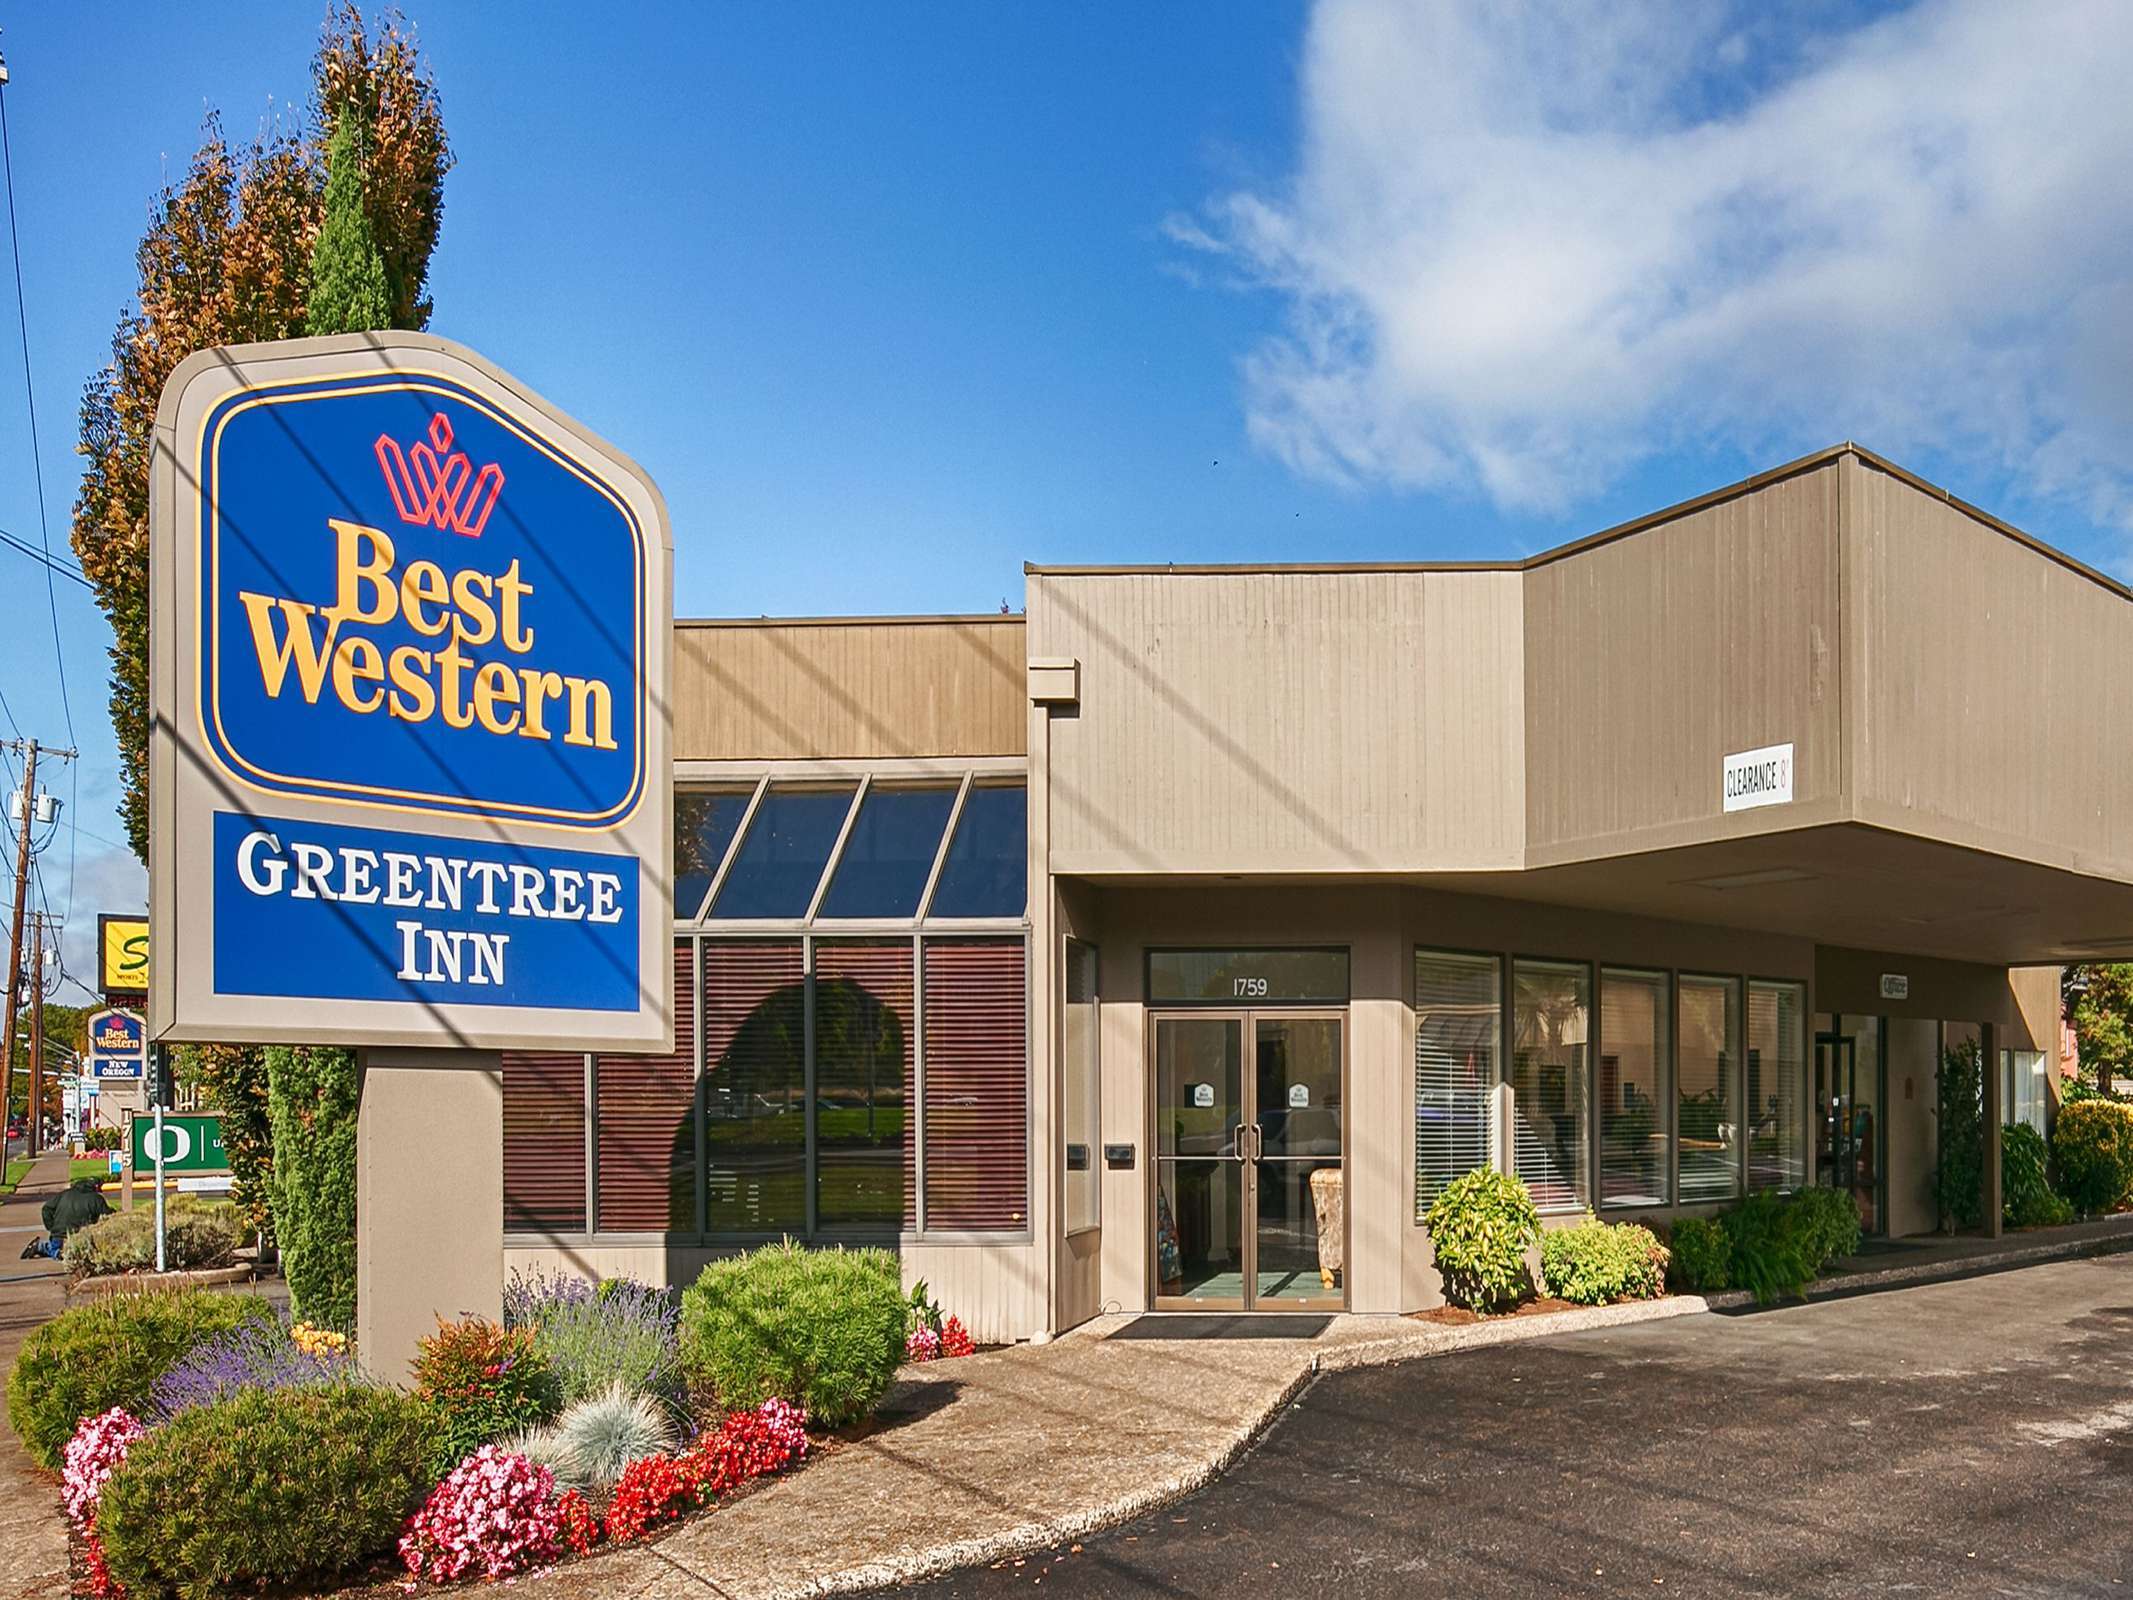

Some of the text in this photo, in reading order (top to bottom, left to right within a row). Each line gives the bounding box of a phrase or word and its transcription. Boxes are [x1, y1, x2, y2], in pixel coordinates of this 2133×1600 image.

[328, 518, 534, 654] Best
[239, 591, 618, 750] Western
[1727, 761, 1777, 798] CLEARANCE
[237, 830, 623, 924] GREENTREE
[396, 920, 509, 986] INN
[1233, 978, 1268, 996] 1759
[96, 1036, 140, 1049] Western
[105, 1028, 129, 1040] Best
[122, 1110, 133, 1168] 1715
[143, 1125, 191, 1163] O
